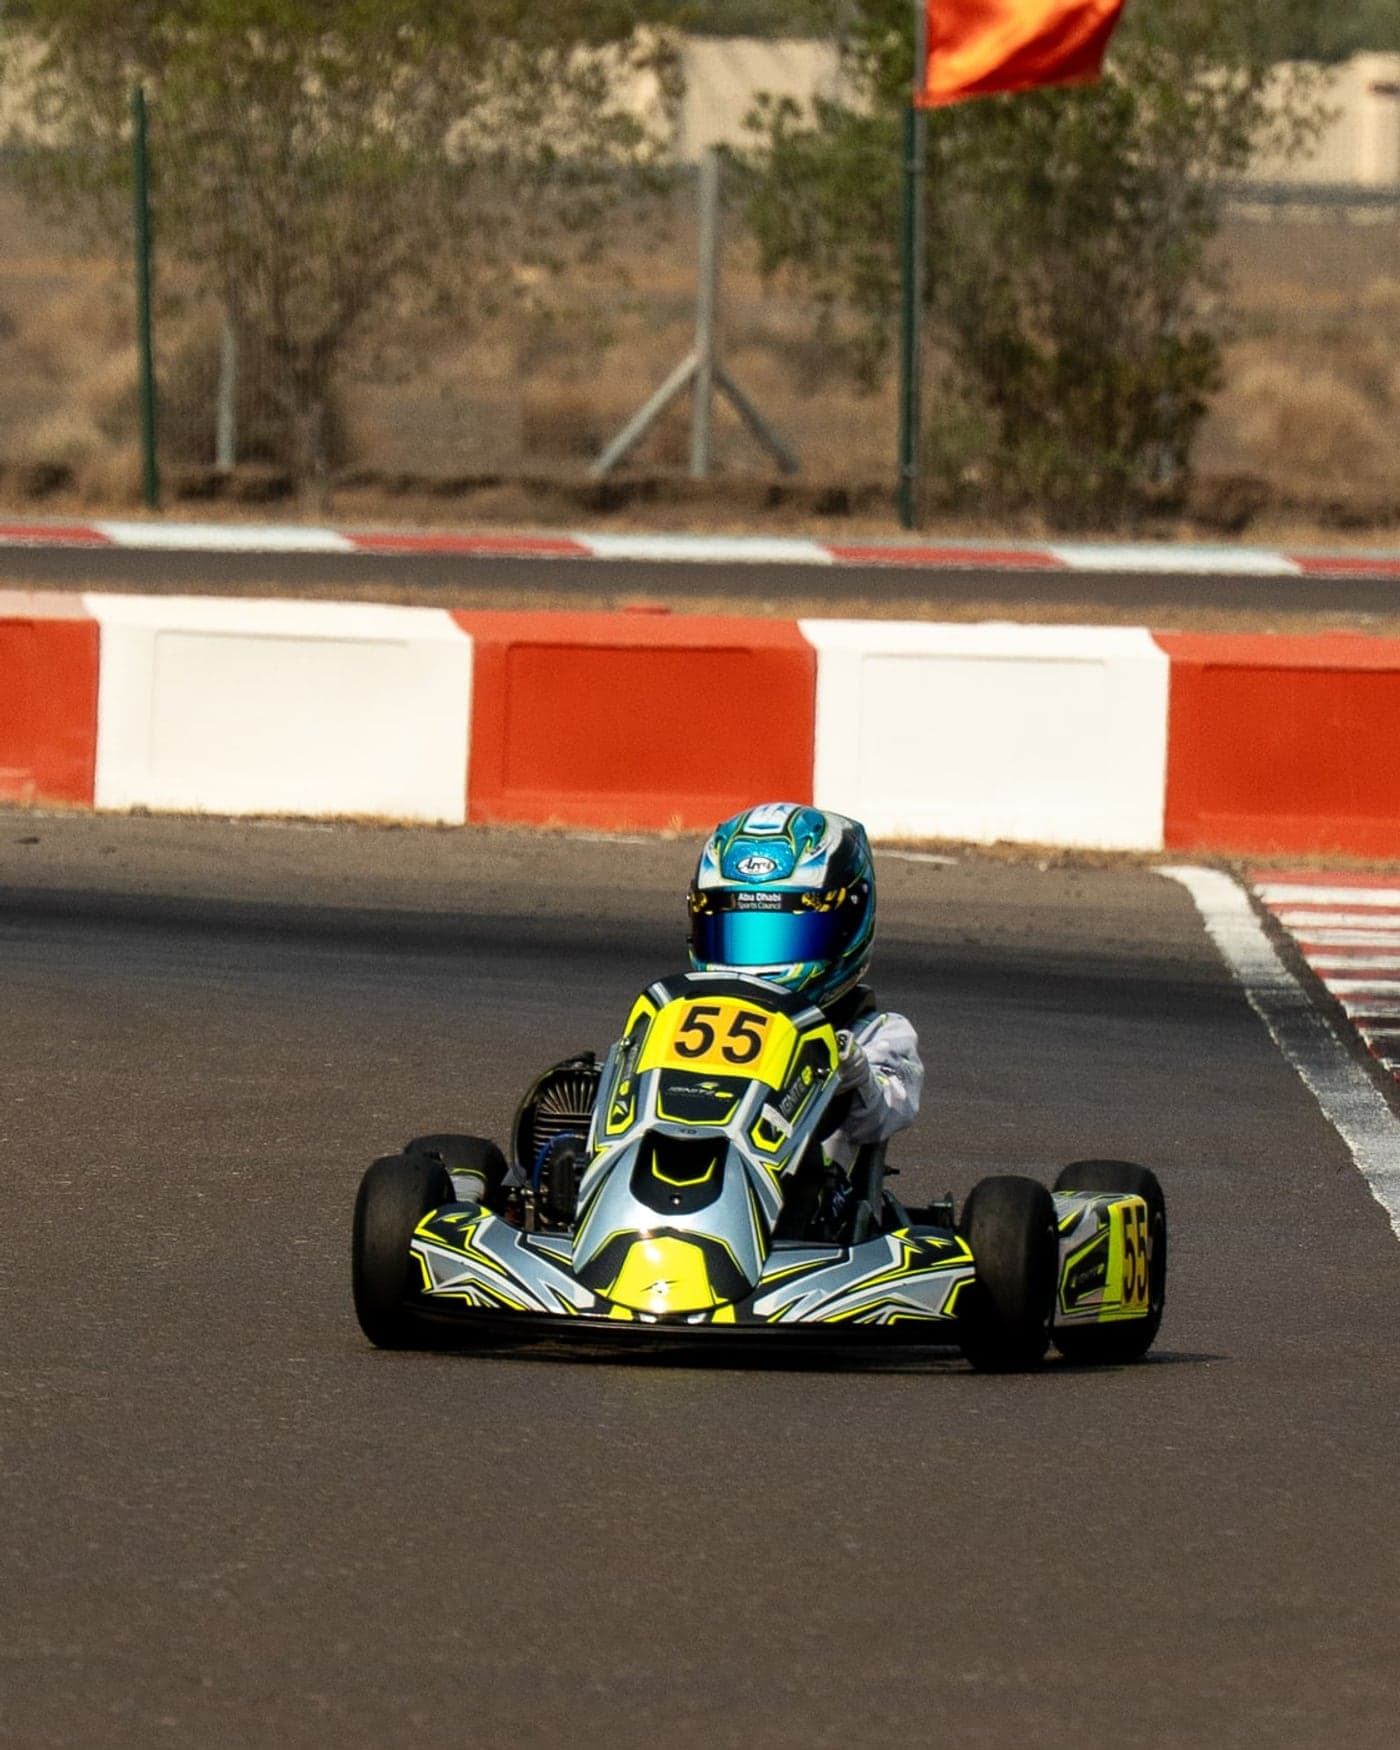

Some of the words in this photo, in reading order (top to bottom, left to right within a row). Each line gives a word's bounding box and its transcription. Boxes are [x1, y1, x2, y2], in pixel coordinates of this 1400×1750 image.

[738, 893, 755, 901] Abu
[756, 893, 781, 901] Dhabi
[738, 902, 757, 910] Sports
[673, 1006, 768, 1065] 55
[1121, 1205, 1148, 1303] 55
